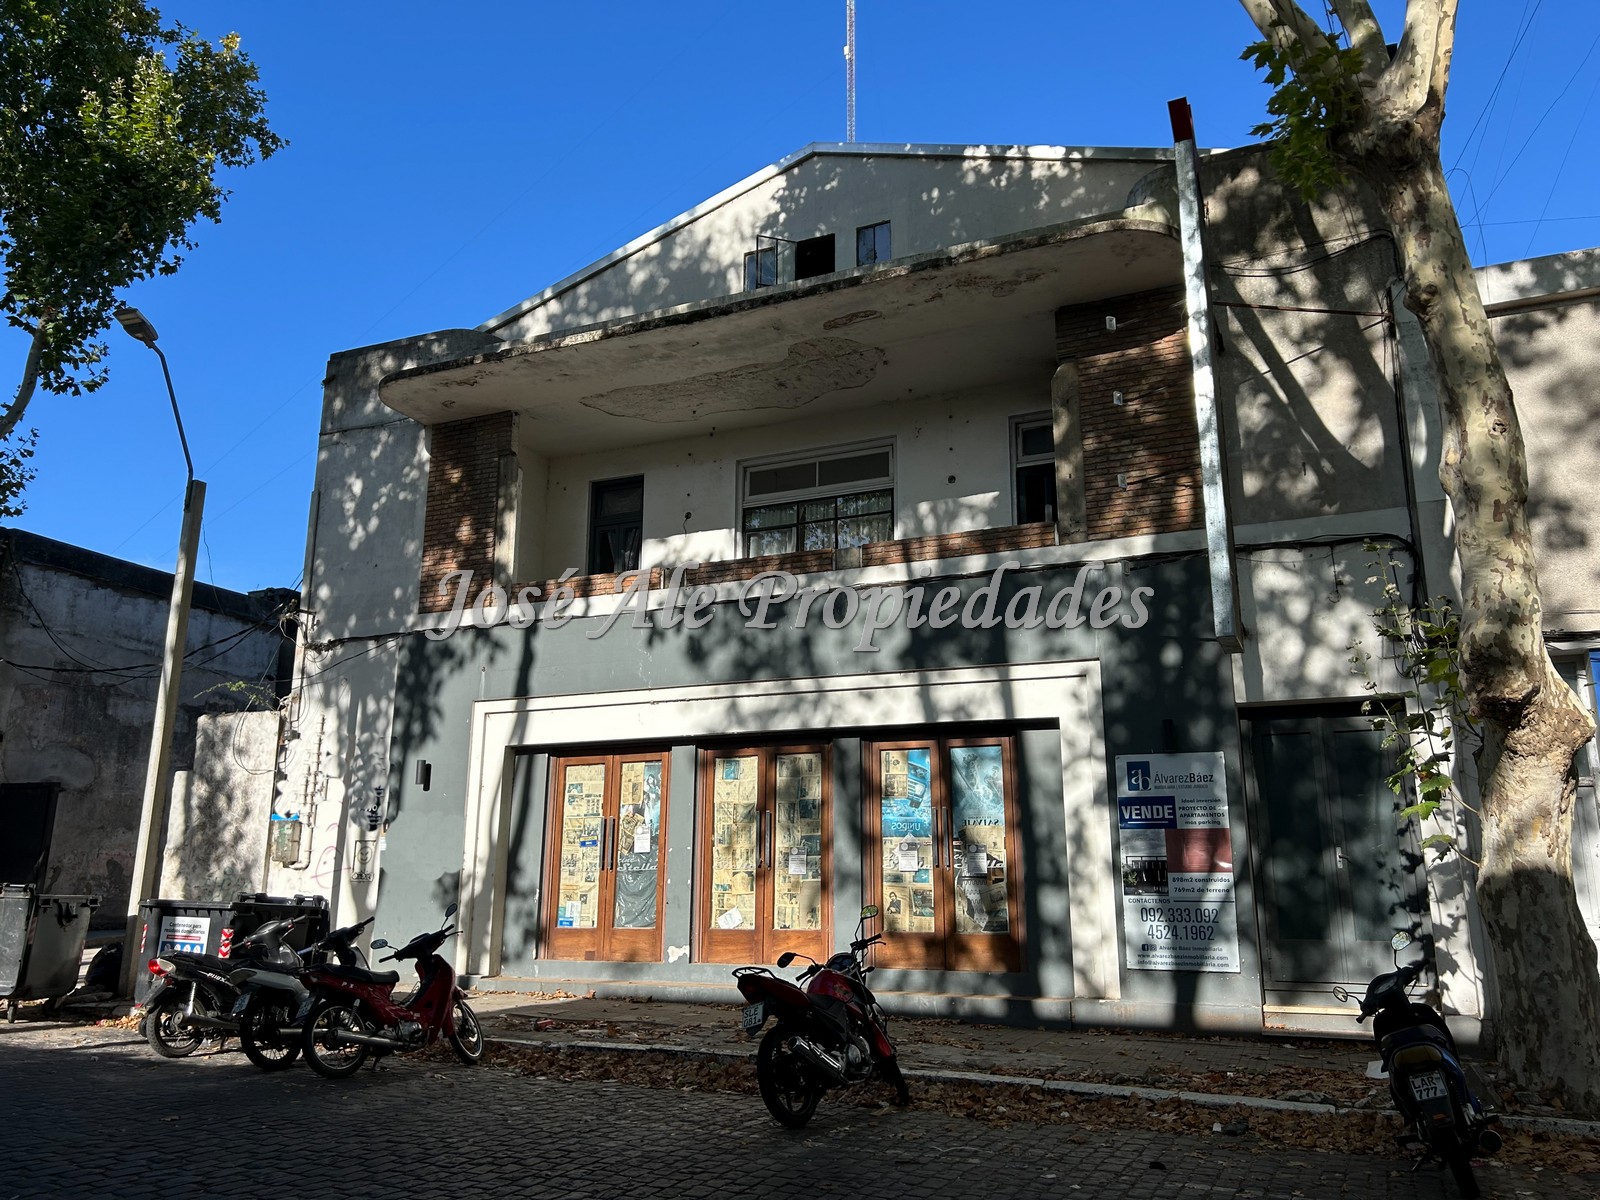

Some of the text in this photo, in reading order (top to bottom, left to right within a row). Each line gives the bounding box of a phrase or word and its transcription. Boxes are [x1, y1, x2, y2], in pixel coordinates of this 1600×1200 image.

[1121, 804, 1173, 820] VENDE
[1140, 907, 1219, 924] 092.333.092
[1147, 924, 1215, 941] 4524.1962
[744, 1007, 759, 1018] SLE
[1411, 1076, 1437, 1089] LAR
[1415, 1086, 1438, 1099] 777
